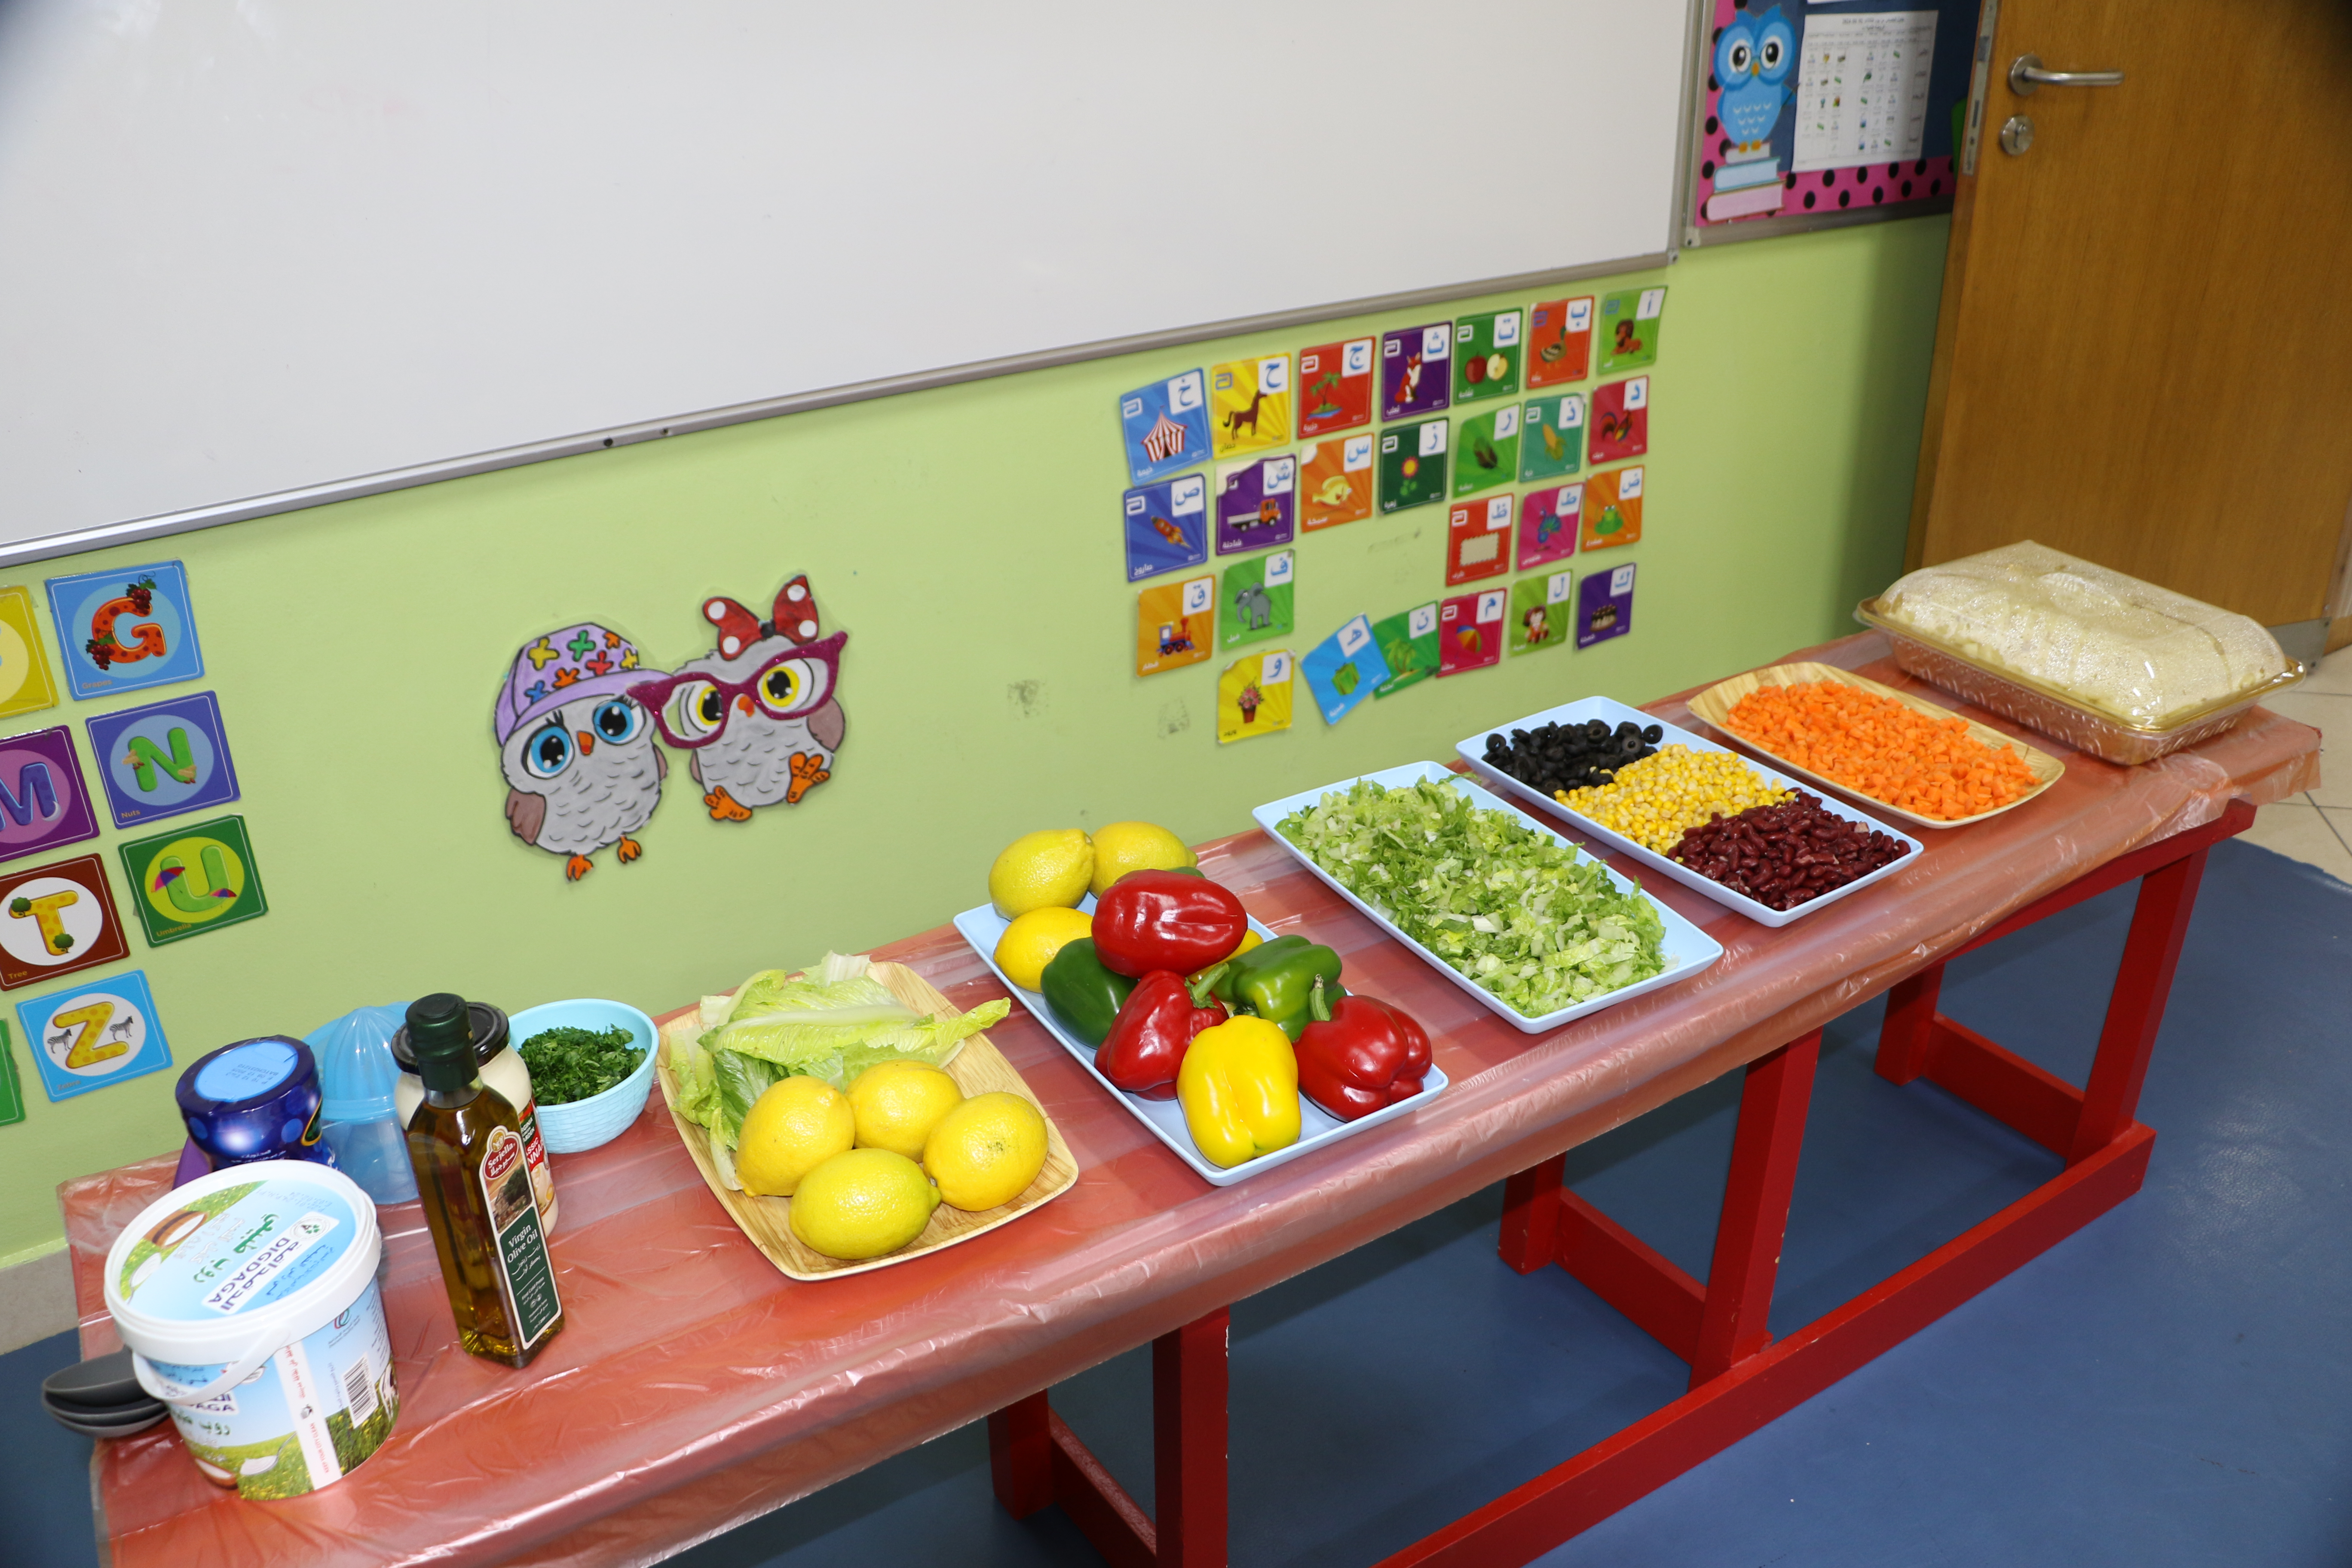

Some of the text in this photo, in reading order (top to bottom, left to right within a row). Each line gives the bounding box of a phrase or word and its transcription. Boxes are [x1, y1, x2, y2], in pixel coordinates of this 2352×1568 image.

[1571, 305, 1586, 327] ب
[1498, 318, 1515, 340] ت
[1427, 332, 1444, 354] ث
[1349, 345, 1364, 369] ج
[1265, 362, 1281, 388] ح
[1178, 378, 1194, 406] خ
[1631, 384, 1640, 401] د
[1566, 400, 1575, 421] ذ
[1500, 412, 1512, 431] ر
[1427, 425, 1437, 450] ز
[1347, 443, 1370, 462] س
[1267, 462, 1290, 489] ش
[1622, 473, 1641, 493] ض
[1175, 486, 1200, 505] ص
[1561, 492, 1577, 506] ط
[1491, 503, 1507, 519] ظ
[1134, 564, 1152, 576] صاروخ
[1271, 557, 1288, 576] ف
[1554, 576, 1565, 597] ل
[1614, 570, 1631, 588] ك
[1191, 584, 1205, 608] ق
[1485, 597, 1496, 617] م
[91, 597, 167, 664] G
[1417, 611, 1429, 630] ن
[1268, 658, 1282, 678] و
[82, 679, 112, 689] Grapes
[128, 727, 196, 792] N
[121, 808, 141, 818] Nuts
[160, 845, 232, 913] U
[9, 890, 79, 956] T
[156, 923, 192, 937] Umbrella
[8, 970, 28, 980] Tree
[52, 1001, 129, 1069] Z
[57, 1079, 81, 1091] Zebra
[524, 1127, 535, 1142] ARDEN
[488, 1142, 513, 1169] Serjella
[490, 1152, 515, 1177] سيرجيلا
[507, 1229, 538, 1263] Olive Oil
[508, 1225, 531, 1248] Virgin
[193, 1214, 279, 1283] روب طبيعي
[511, 1243, 540, 1275] زيت زيتون
[208, 1237, 290, 1302] DIGDAGA
[220, 1241, 302, 1311] الدقداقة
[199, 1422, 230, 1435] روب
